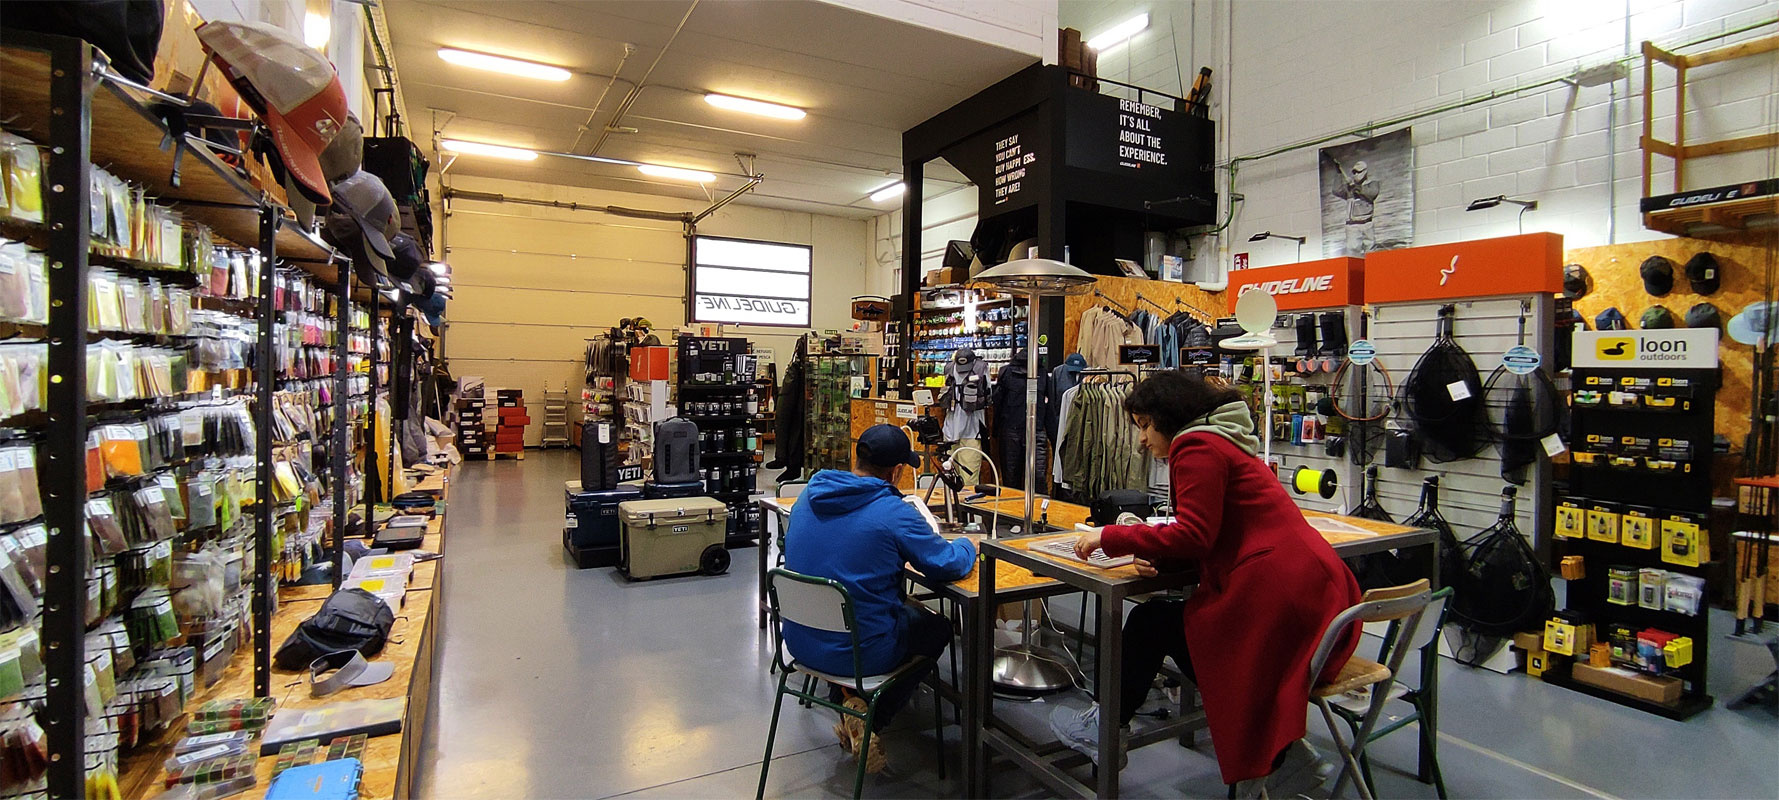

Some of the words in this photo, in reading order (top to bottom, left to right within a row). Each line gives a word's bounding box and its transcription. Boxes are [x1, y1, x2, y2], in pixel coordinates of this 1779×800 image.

[1120, 99, 1162, 120] REMEMBER,
[1136, 119, 1151, 132] ALL
[996, 138, 1009, 151] THEY
[1009, 134, 1018, 146] SAY
[1120, 130, 1145, 146] ABOUT
[1147, 135, 1162, 149] THE
[996, 151, 1006, 162] YOU
[1120, 145, 1168, 165] EXPERIENCE.
[996, 163, 1005, 175] BUY
[1007, 167, 1026, 182] WRONG
[996, 186, 1008, 198] THEY
[699, 340, 729, 351] YETI
[1640, 337, 1687, 352] loon
[1640, 353, 1687, 361] outdoors
[618, 467, 641, 480] YETI
